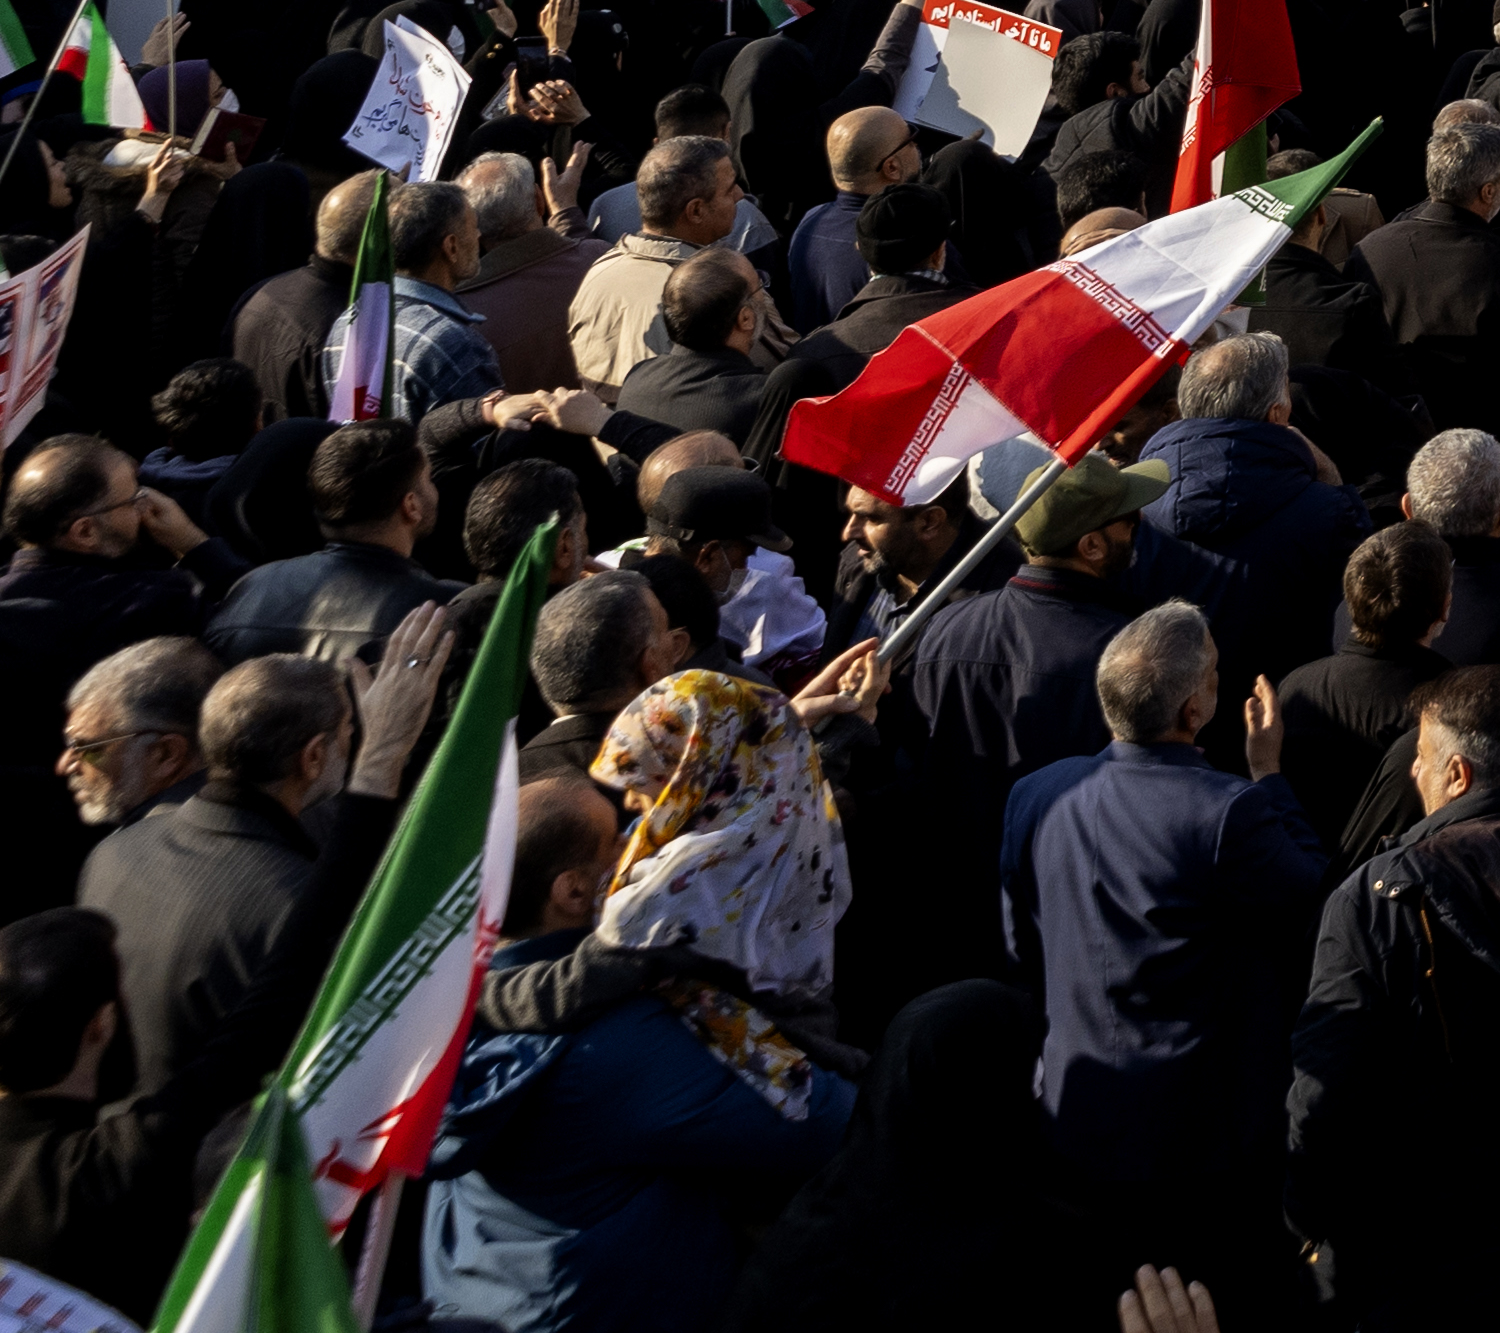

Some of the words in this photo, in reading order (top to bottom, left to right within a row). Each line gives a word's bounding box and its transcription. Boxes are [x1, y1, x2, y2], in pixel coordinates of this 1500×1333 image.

[930, 2, 955, 22] ایم
[1028, 28, 1039, 47] تا
[1039, 32, 1052, 54] ما
